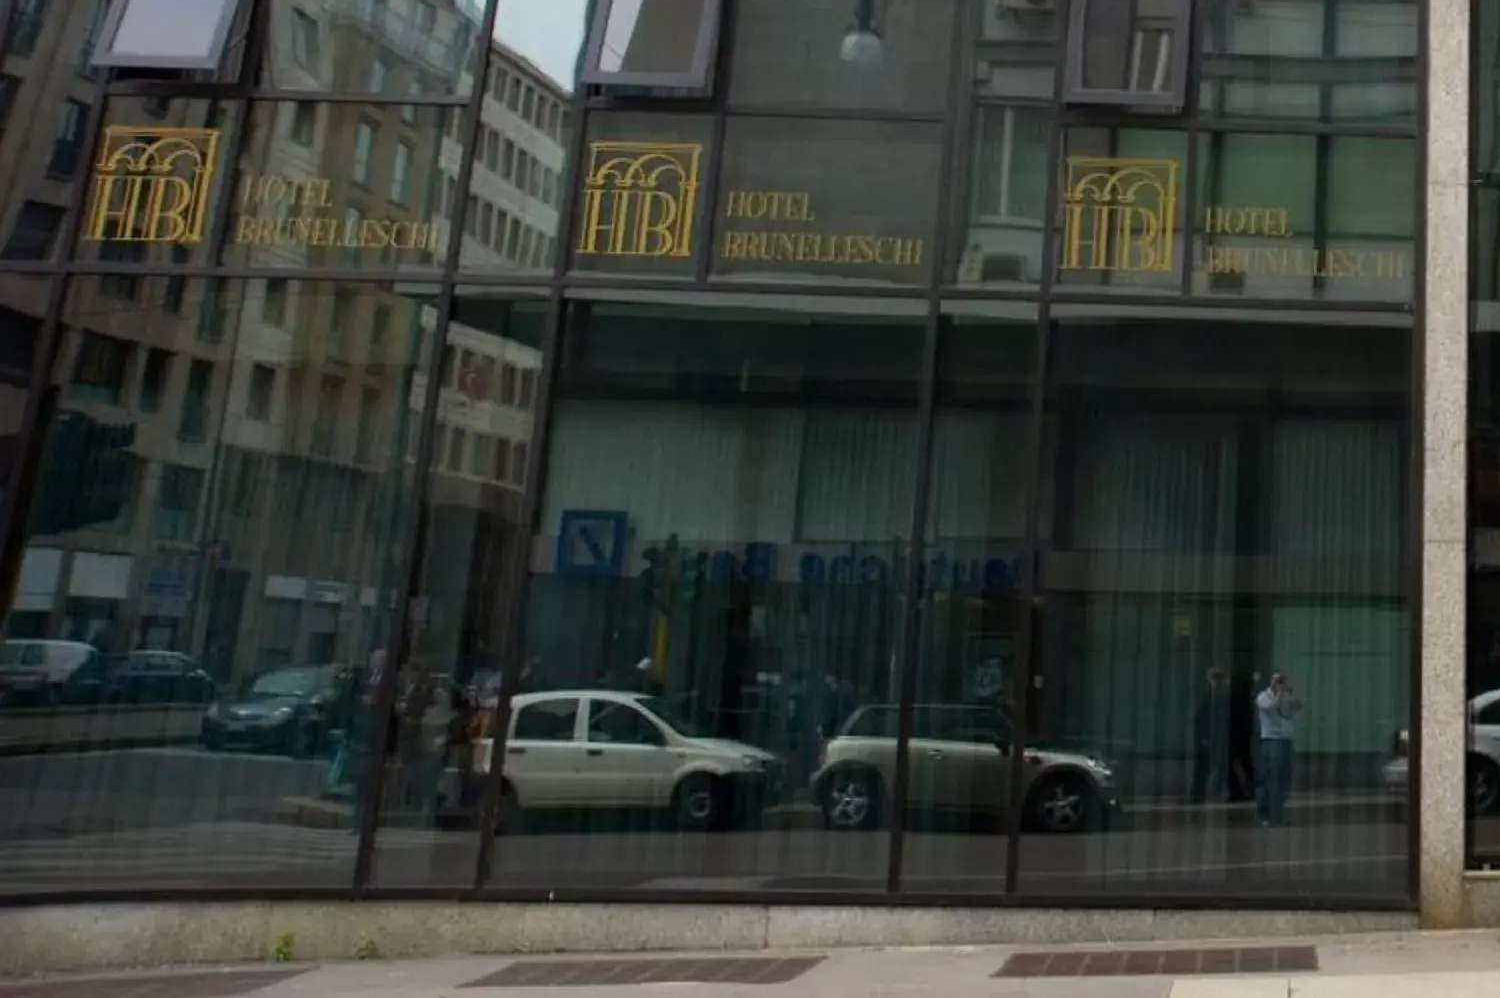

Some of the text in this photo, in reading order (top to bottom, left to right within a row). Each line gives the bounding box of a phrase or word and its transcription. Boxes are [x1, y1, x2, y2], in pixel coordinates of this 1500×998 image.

[243, 176, 334, 208] HOTEL
[726, 190, 816, 221] HOTEL
[1205, 205, 1294, 238] HOTEL
[720, 230, 924, 266] BRUNELLESCHI
